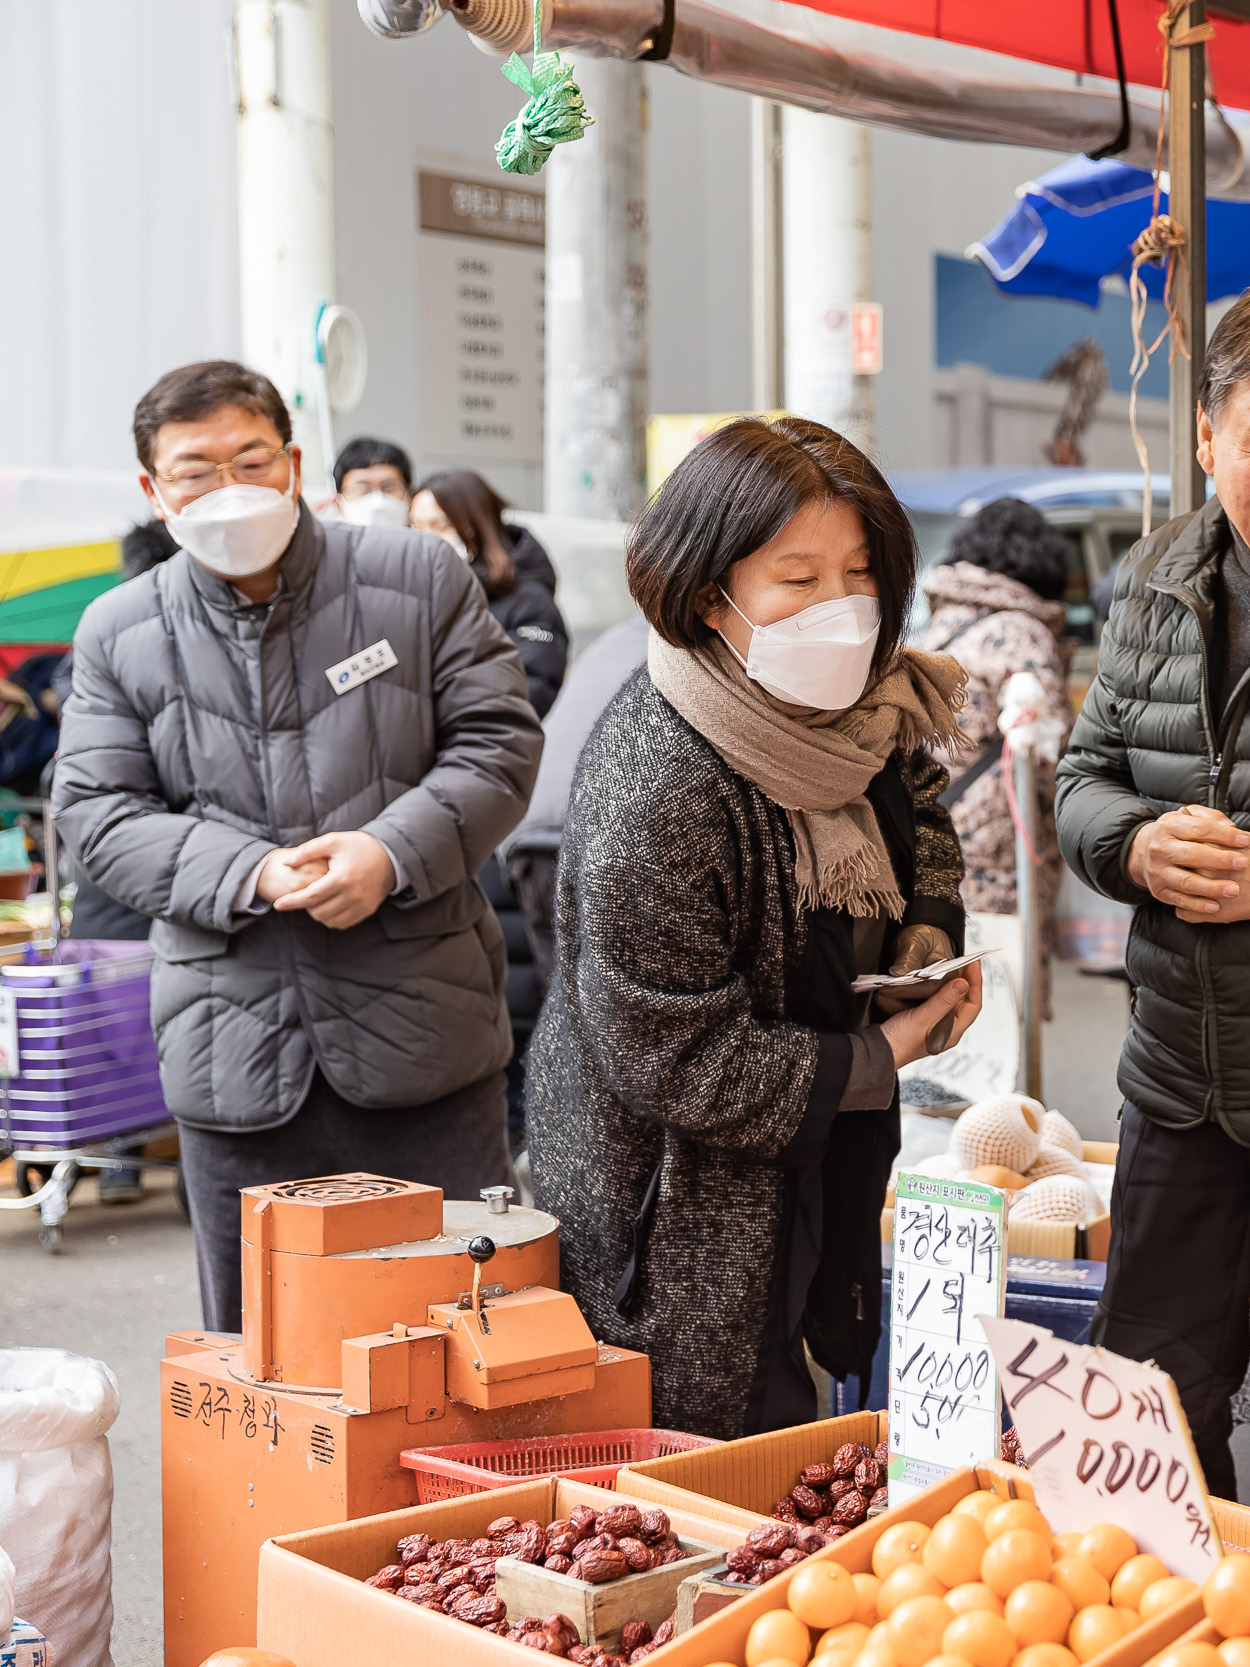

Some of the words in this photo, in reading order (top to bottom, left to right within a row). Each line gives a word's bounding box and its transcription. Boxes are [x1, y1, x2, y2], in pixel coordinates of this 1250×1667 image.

[919, 1182, 939, 1196] 원산지
[943, 1186, 965, 1201] 표시판
[900, 1342, 990, 1392] 10,000
[1006, 1337, 1172, 1433] 40개
